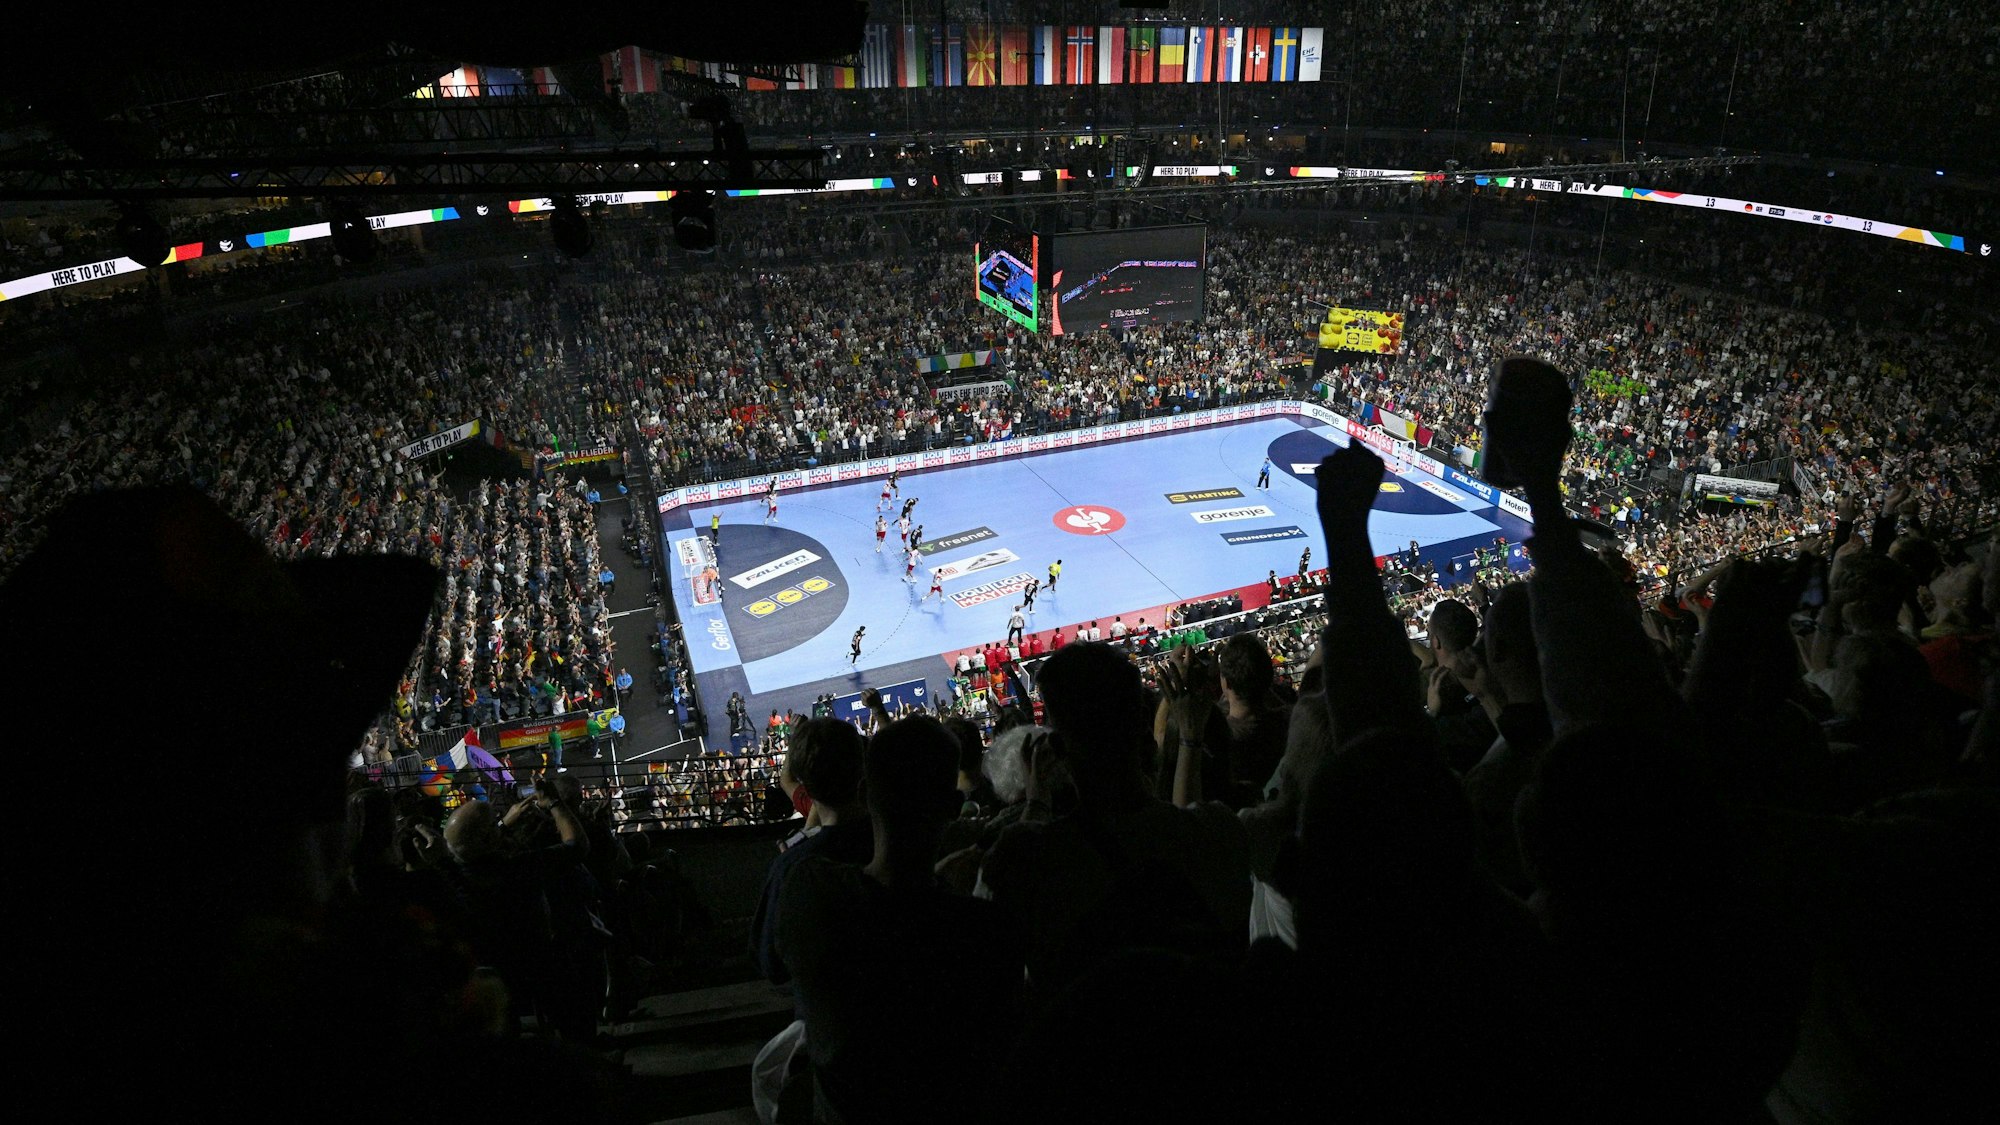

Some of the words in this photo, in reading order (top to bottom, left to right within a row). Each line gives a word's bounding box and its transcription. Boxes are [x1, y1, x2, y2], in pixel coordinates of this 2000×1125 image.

[1161, 167, 1174, 175] HERE
[1176, 167, 1183, 175] TO
[1184, 167, 1198, 176] PLAY
[1540, 180, 1555, 190] HERE
[605, 193, 624, 203] PLAY
[1705, 198, 1716, 207] 13
[1862, 221, 1873, 231] 13
[51, 269, 77, 286] HERE
[78, 266, 92, 280] TO
[92, 260, 116, 278] PLAY
[1239, 410, 1255, 419] MOLY
[1260, 407, 1277, 416] MOLY
[1282, 406, 1301, 414] MOLY
[1195, 416, 1212, 425] MOLY
[1217, 413, 1234, 422] MOLY
[1312, 407, 1339, 424] gorenje
[1150, 423, 1167, 432] MOLY
[1173, 420, 1190, 429] MOLY
[1103, 430, 1120, 439] MOLY
[1126, 427, 1144, 436] MOLY
[410, 440, 430, 457] HERE
[432, 437, 442, 448] TO
[443, 429, 461, 445] PLAY
[1003, 439, 1022, 448] LIQUI
[1028, 436, 1047, 444] LIQUI
[1054, 437, 1073, 447] MOLY
[1078, 434, 1097, 443] MOLY
[1356, 428, 1392, 450] STRAUSS
[950, 447, 970, 456] LIQUI
[977, 443, 996, 452] LIQUI
[1003, 445, 1022, 455] MOLY
[1028, 442, 1048, 451] MOLY
[568, 451, 579, 459] TV
[580, 446, 614, 458] FLIEDEN
[923, 451, 943, 460] LIQUI
[977, 449, 997, 459] MOLY
[895, 455, 916, 464] LIQUI
[923, 457, 944, 466] MOLY
[950, 453, 971, 463] MOLY
[838, 463, 860, 473] LIQUI
[867, 459, 888, 468] LIQUI
[896, 461, 917, 471] MOLY
[1420, 460, 1435, 472] MOLY
[809, 468, 831, 477] LIQUI
[839, 470, 861, 480] MOLY
[868, 466, 889, 475] MOLY
[780, 472, 802, 482] LIQUI
[810, 474, 832, 484] MOLY
[718, 481, 741, 491] LIQUI
[780, 479, 803, 489] MOLY
[1451, 472, 1492, 495] FALKEN
[686, 485, 710, 496] LIQUI
[719, 488, 742, 499] MOLY
[1188, 490, 1239, 500] HARTING
[660, 491, 679, 504] LIQUI
[687, 493, 711, 503] MOLY
[660, 498, 681, 513] MOLY
[1505, 498, 1528, 514] Hotel?
[1200, 508, 1266, 521] gorenje
[939, 530, 993, 548] freenet
[1227, 531, 1290, 542] GRUNDFOS
[746, 554, 806, 581] FALKEN
[952, 583, 994, 600] LIQUI
[994, 572, 1034, 588] LIQUI
[958, 590, 1001, 607] MOLY
[707, 619, 731, 650] Gerflor
